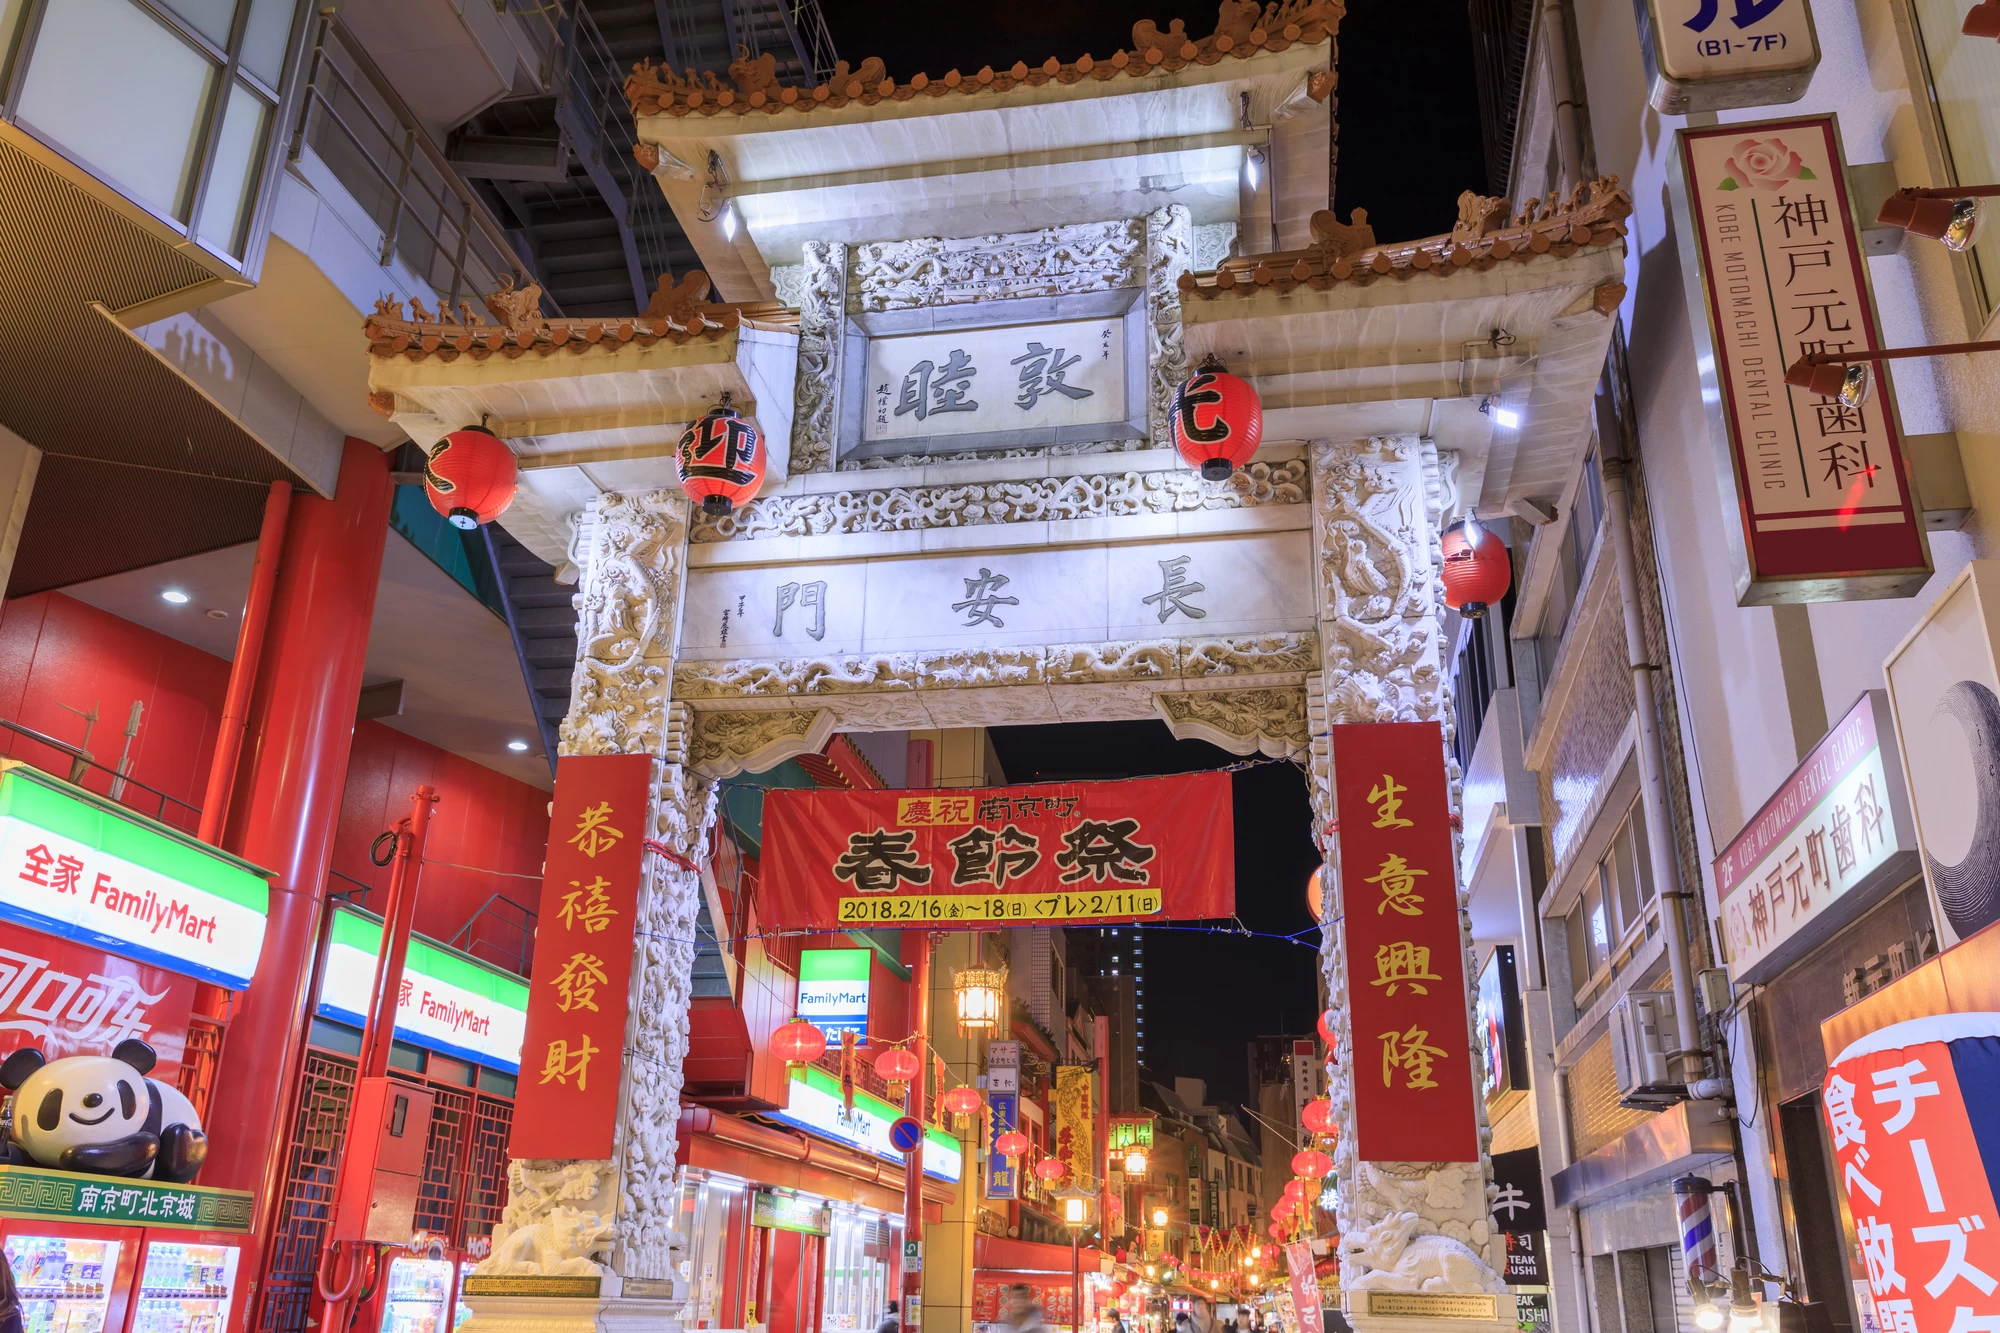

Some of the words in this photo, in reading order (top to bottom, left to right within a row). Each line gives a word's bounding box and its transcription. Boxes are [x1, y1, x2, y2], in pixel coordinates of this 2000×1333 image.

[1715, 203, 1741, 244] KOBE
[1723, 251, 1760, 348] MOTOMACHI
[1742, 356, 1773, 421] DENTAL
[1755, 430, 1786, 489] CLINIC
[900, 799, 971, 824] 慶祝
[1721, 856, 1734, 890] 2F
[1739, 833, 1757, 871] KOBE
[1757, 787, 1799, 850] MOTOMACHI
[1799, 761, 1832, 807] DENTAL
[1834, 717, 1866, 773] CLINIC
[1748, 773, 1886, 949] 神戸元町歯科
[18, 843, 85, 896] 全家
[90, 872, 217, 944] FamilyMart
[1364, 773, 1448, 1092] 生意興隆
[398, 978, 414, 1008] 家
[420, 990, 490, 1037] FamilyMart
[800, 992, 867, 1007] FamilyMart
[77, 1184, 196, 1220] 南京町北京城
